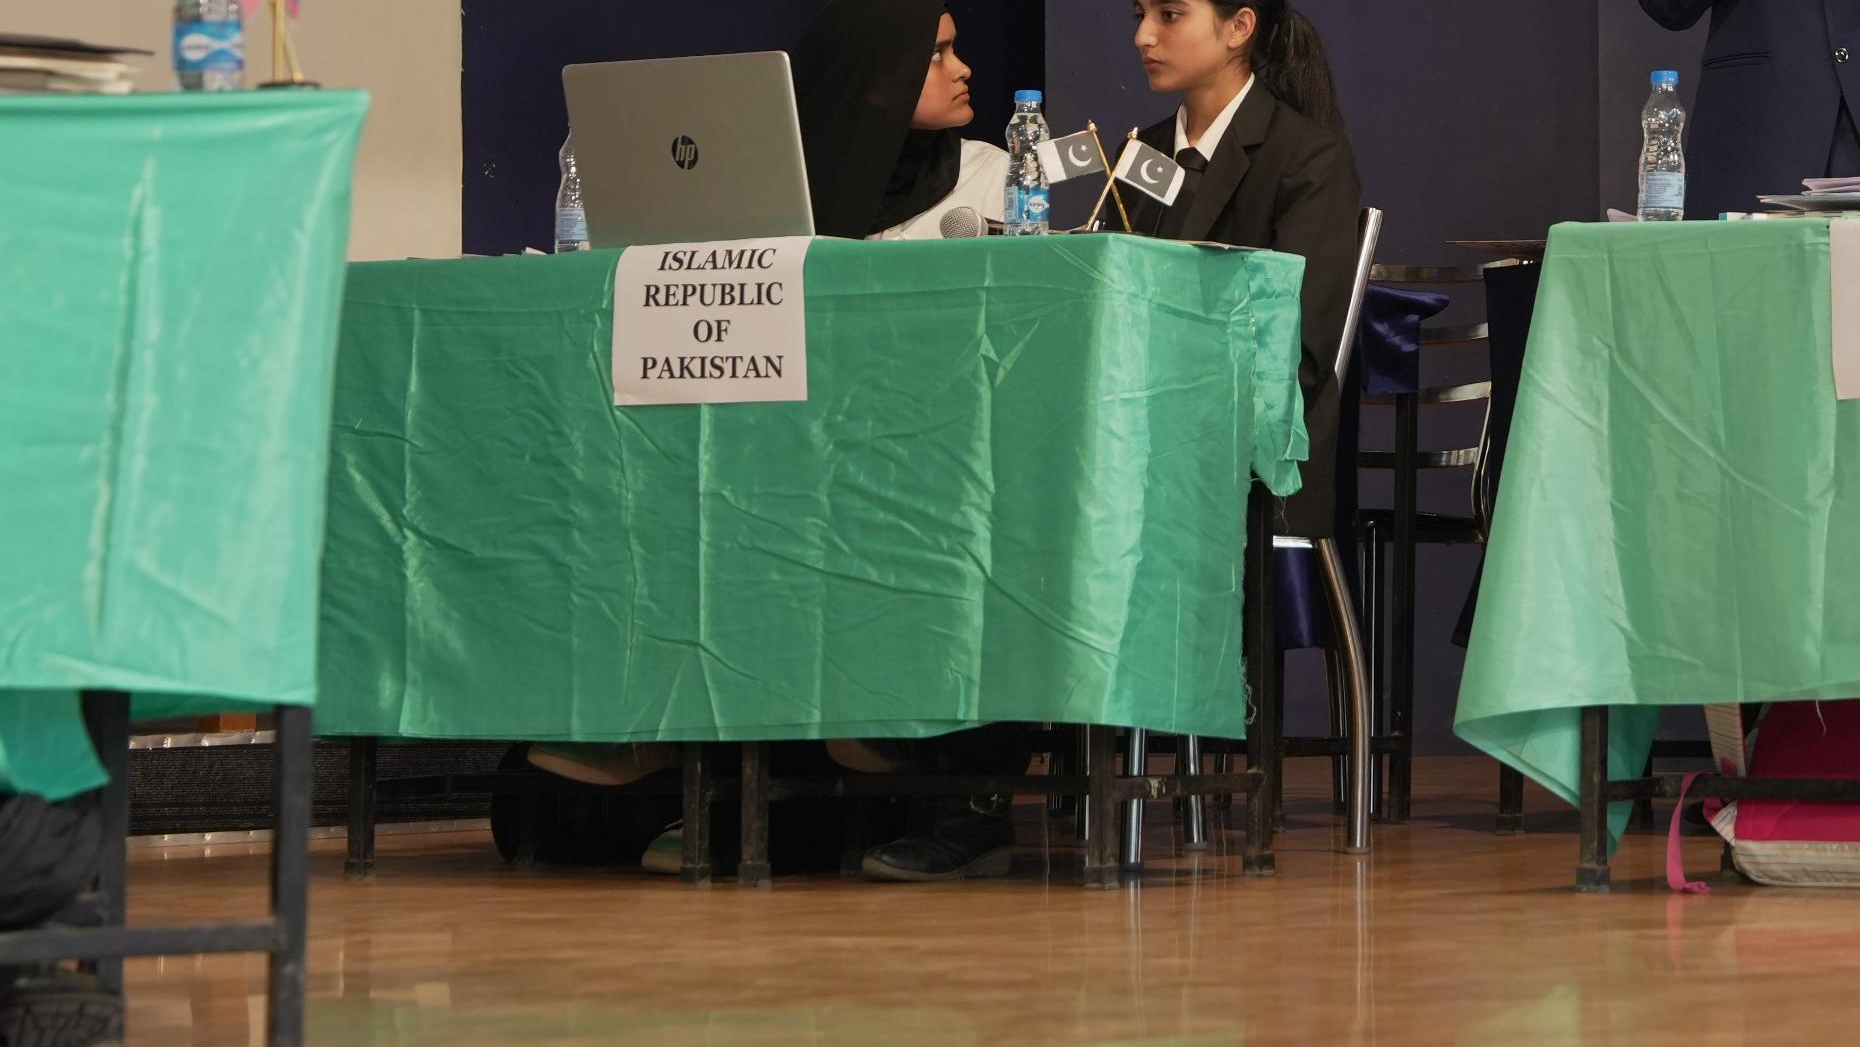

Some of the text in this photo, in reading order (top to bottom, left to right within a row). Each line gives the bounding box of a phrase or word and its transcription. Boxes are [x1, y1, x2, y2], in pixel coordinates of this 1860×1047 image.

[674, 135, 696, 170] hp
[657, 248, 777, 271] ISLAMIC
[642, 281, 783, 307] REPUBLIC
[693, 319, 731, 343] OF
[640, 355, 784, 380] PAKISTAN
